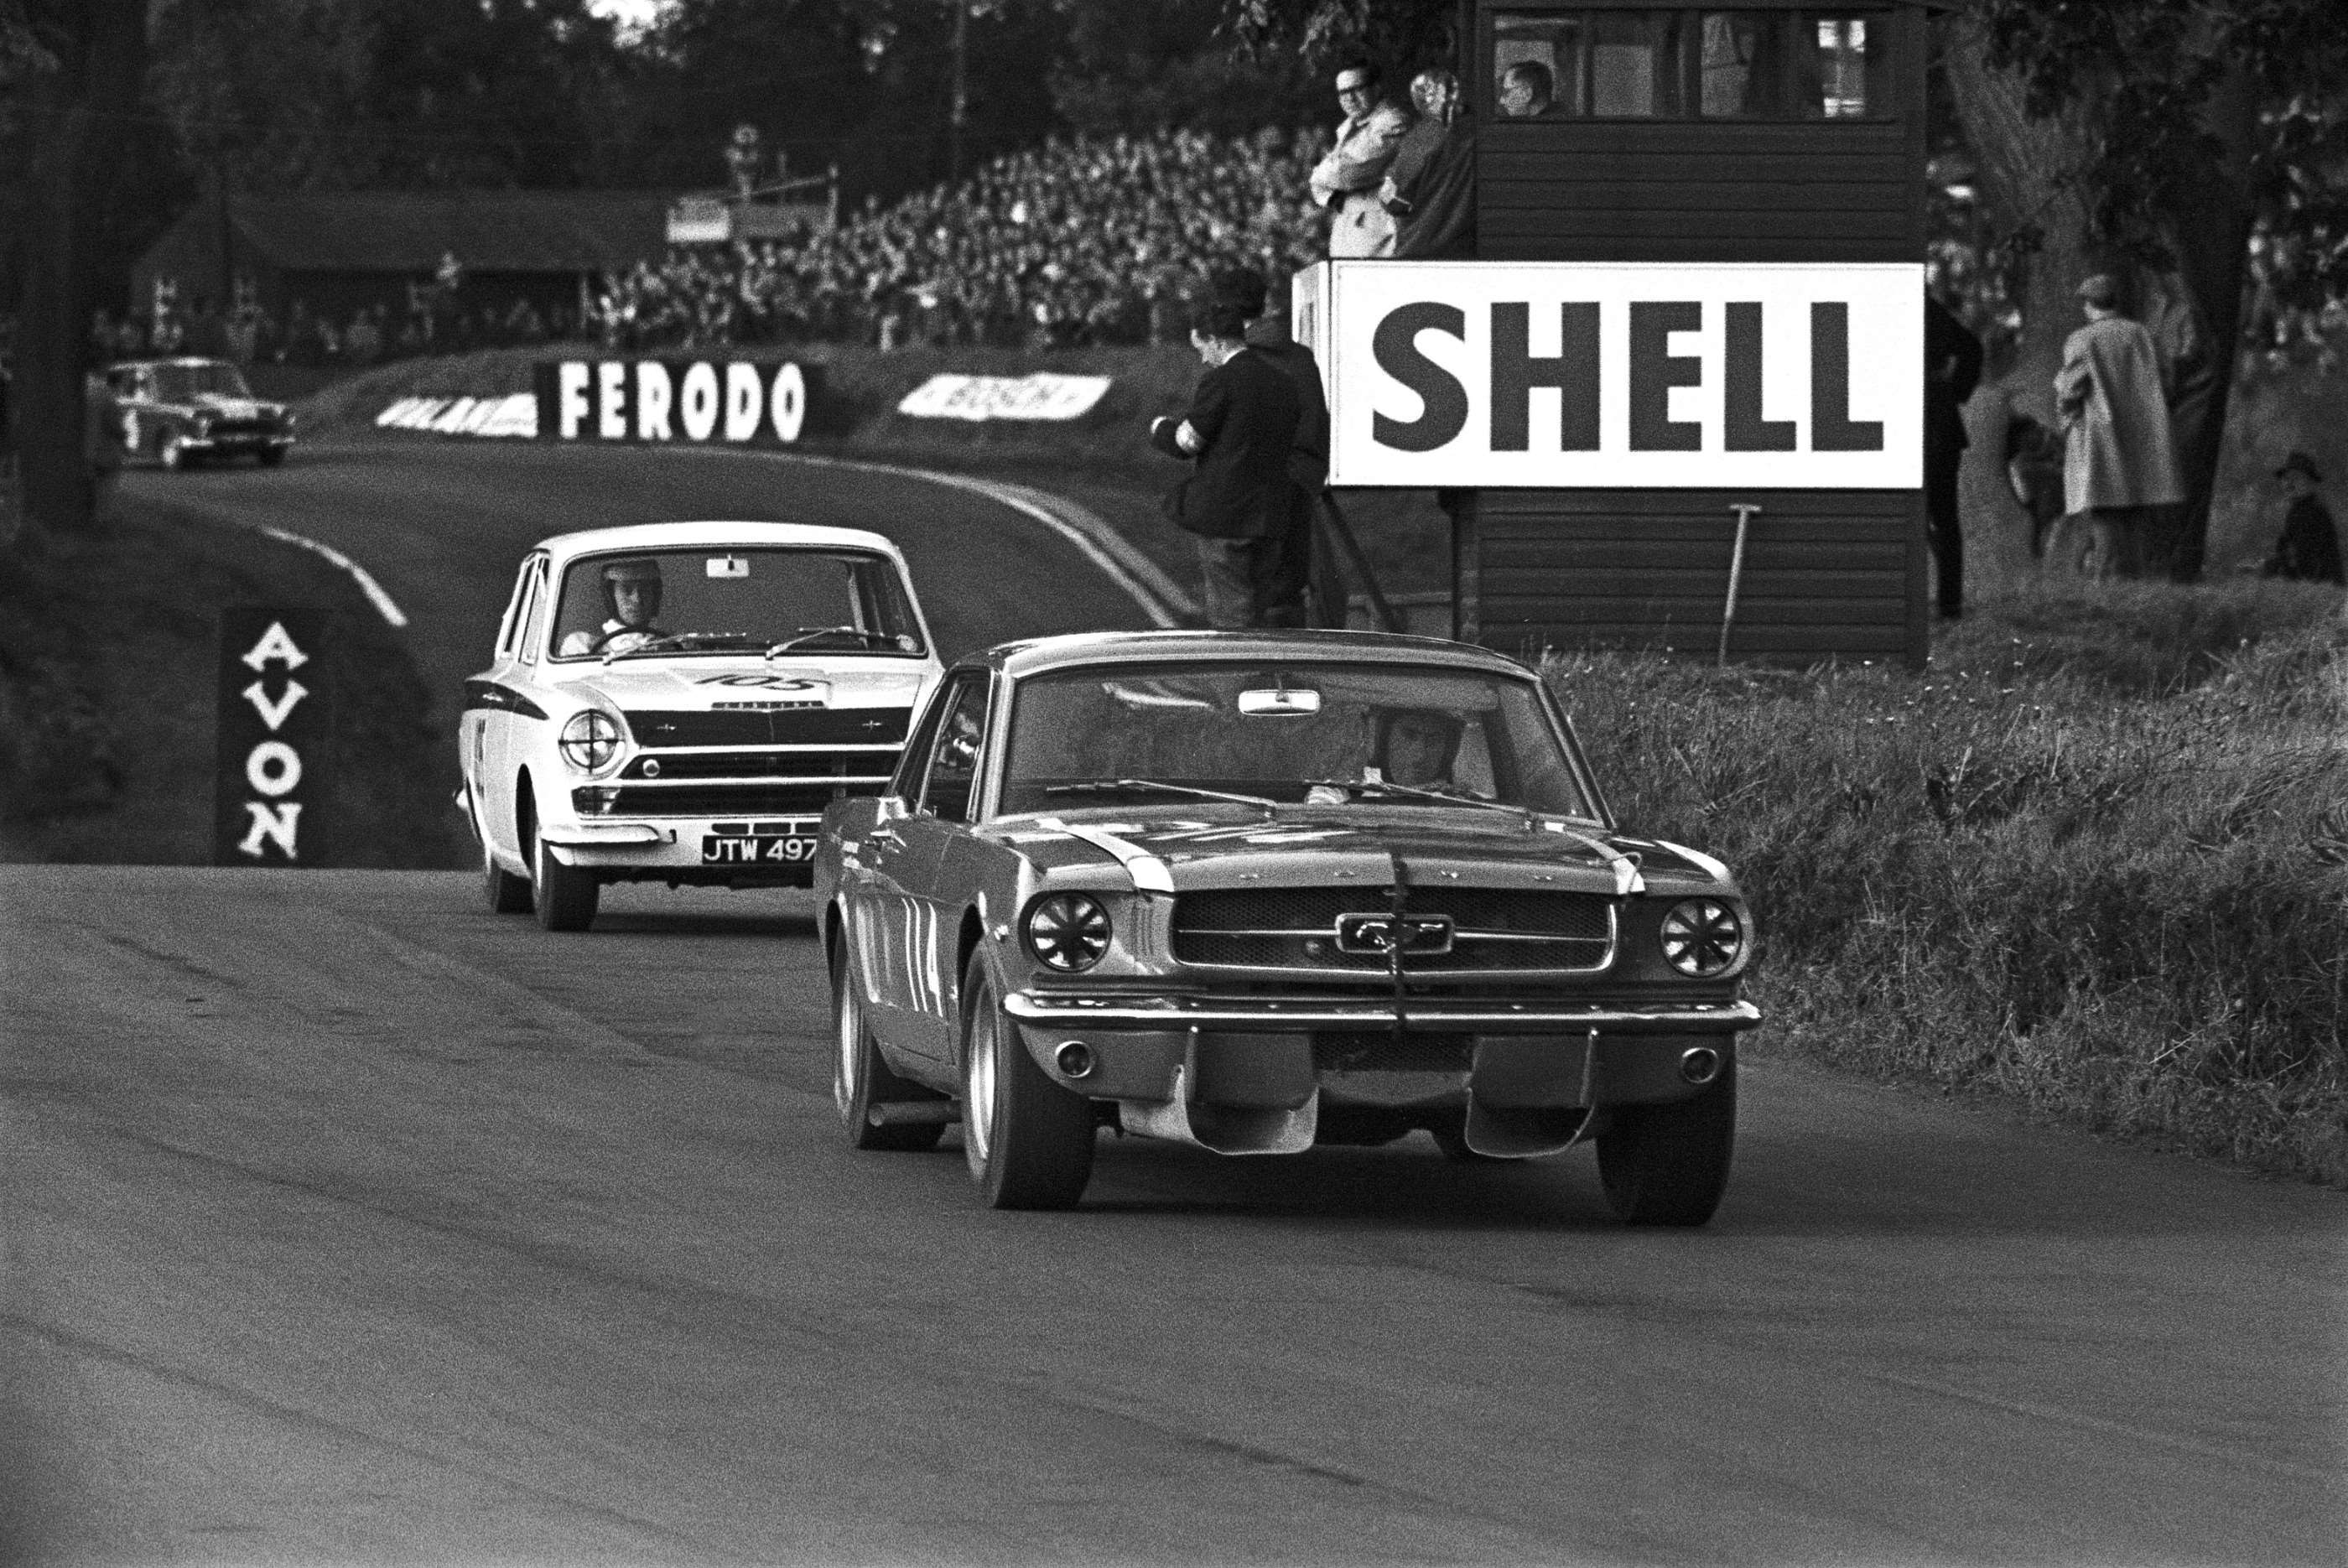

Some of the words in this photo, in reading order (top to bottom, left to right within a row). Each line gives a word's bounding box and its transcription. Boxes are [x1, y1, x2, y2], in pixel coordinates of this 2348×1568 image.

[559, 361, 805, 441] FERODO
[1372, 302, 1883, 452] SHELL
[694, 673, 831, 691] 105
[238, 621, 309, 859] AVON
[704, 839, 758, 861] JTW
[766, 839, 818, 861] 497
